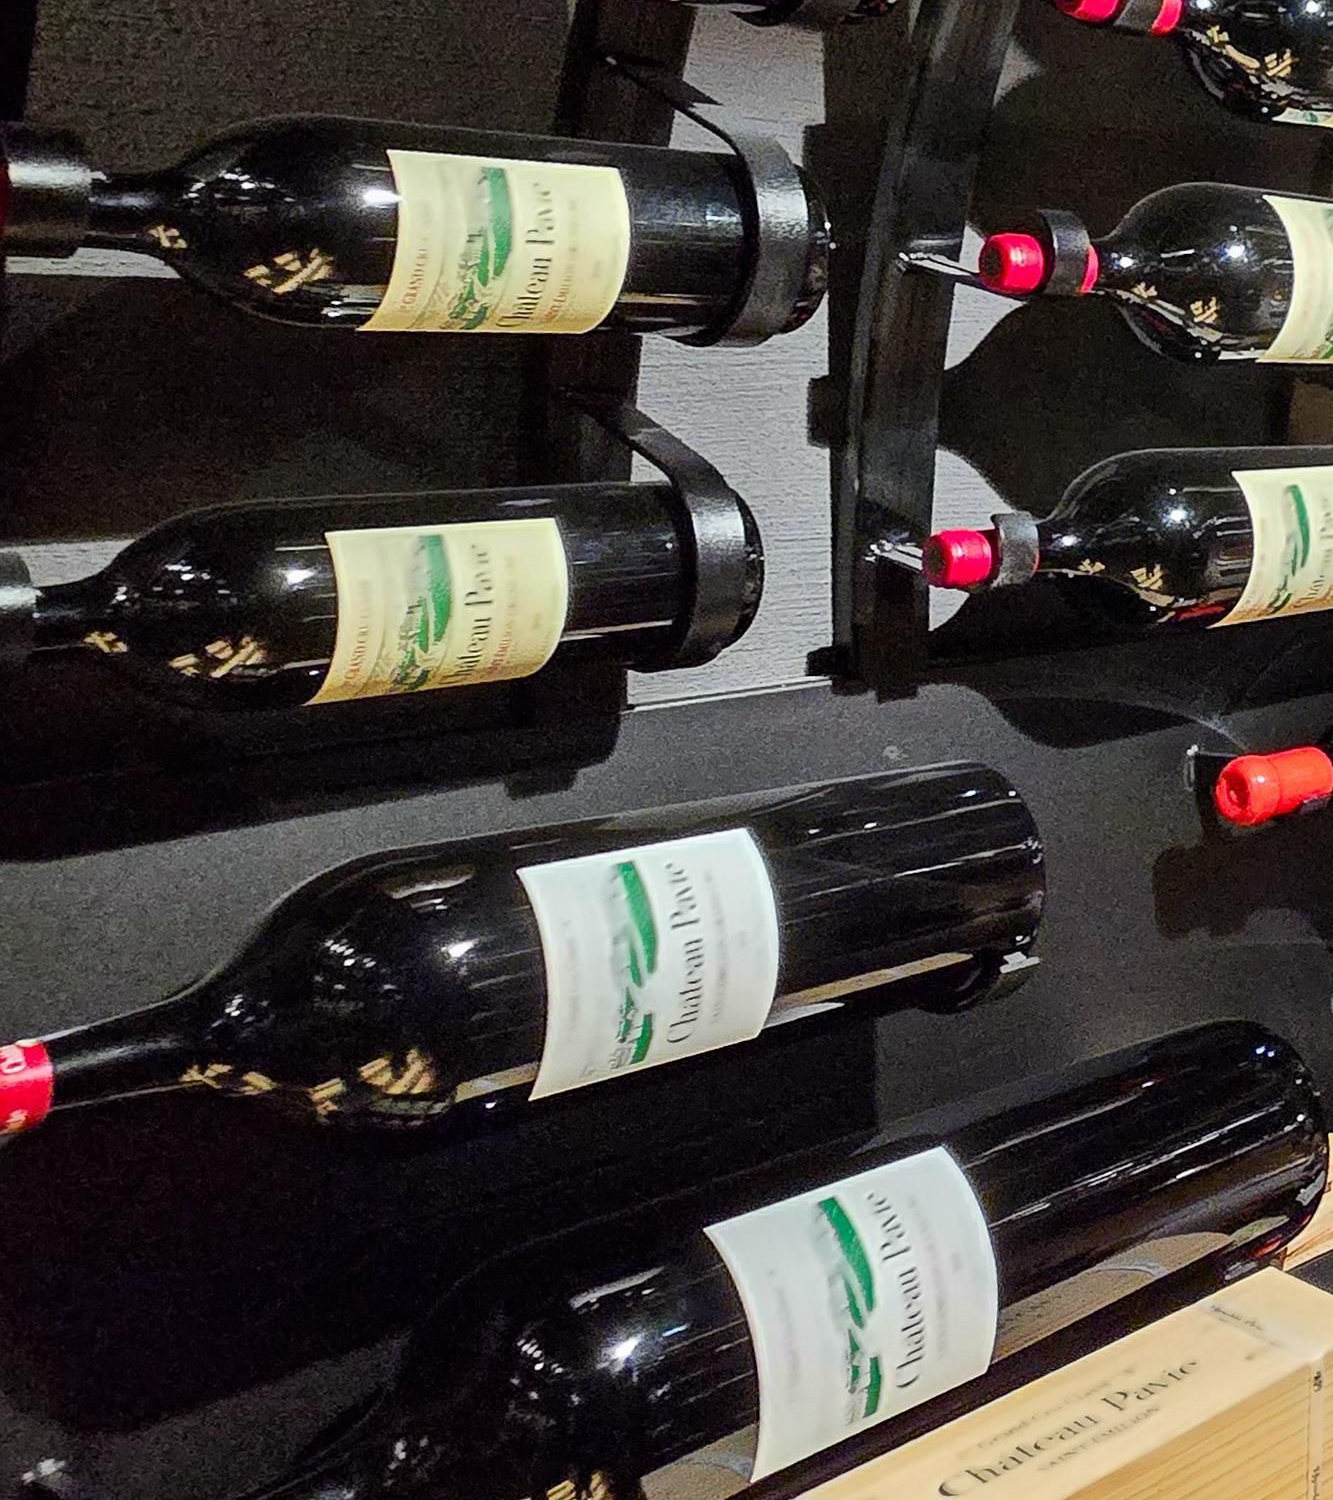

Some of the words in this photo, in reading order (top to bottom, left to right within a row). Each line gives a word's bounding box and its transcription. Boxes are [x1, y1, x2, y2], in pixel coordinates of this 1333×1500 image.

[496, 257, 553, 328] Château
[667, 938, 704, 1043] Château
[866, 1192, 912, 1261] Pavie
[896, 1267, 924, 1389] Château
[1101, 1361, 1198, 1412] Pavie
